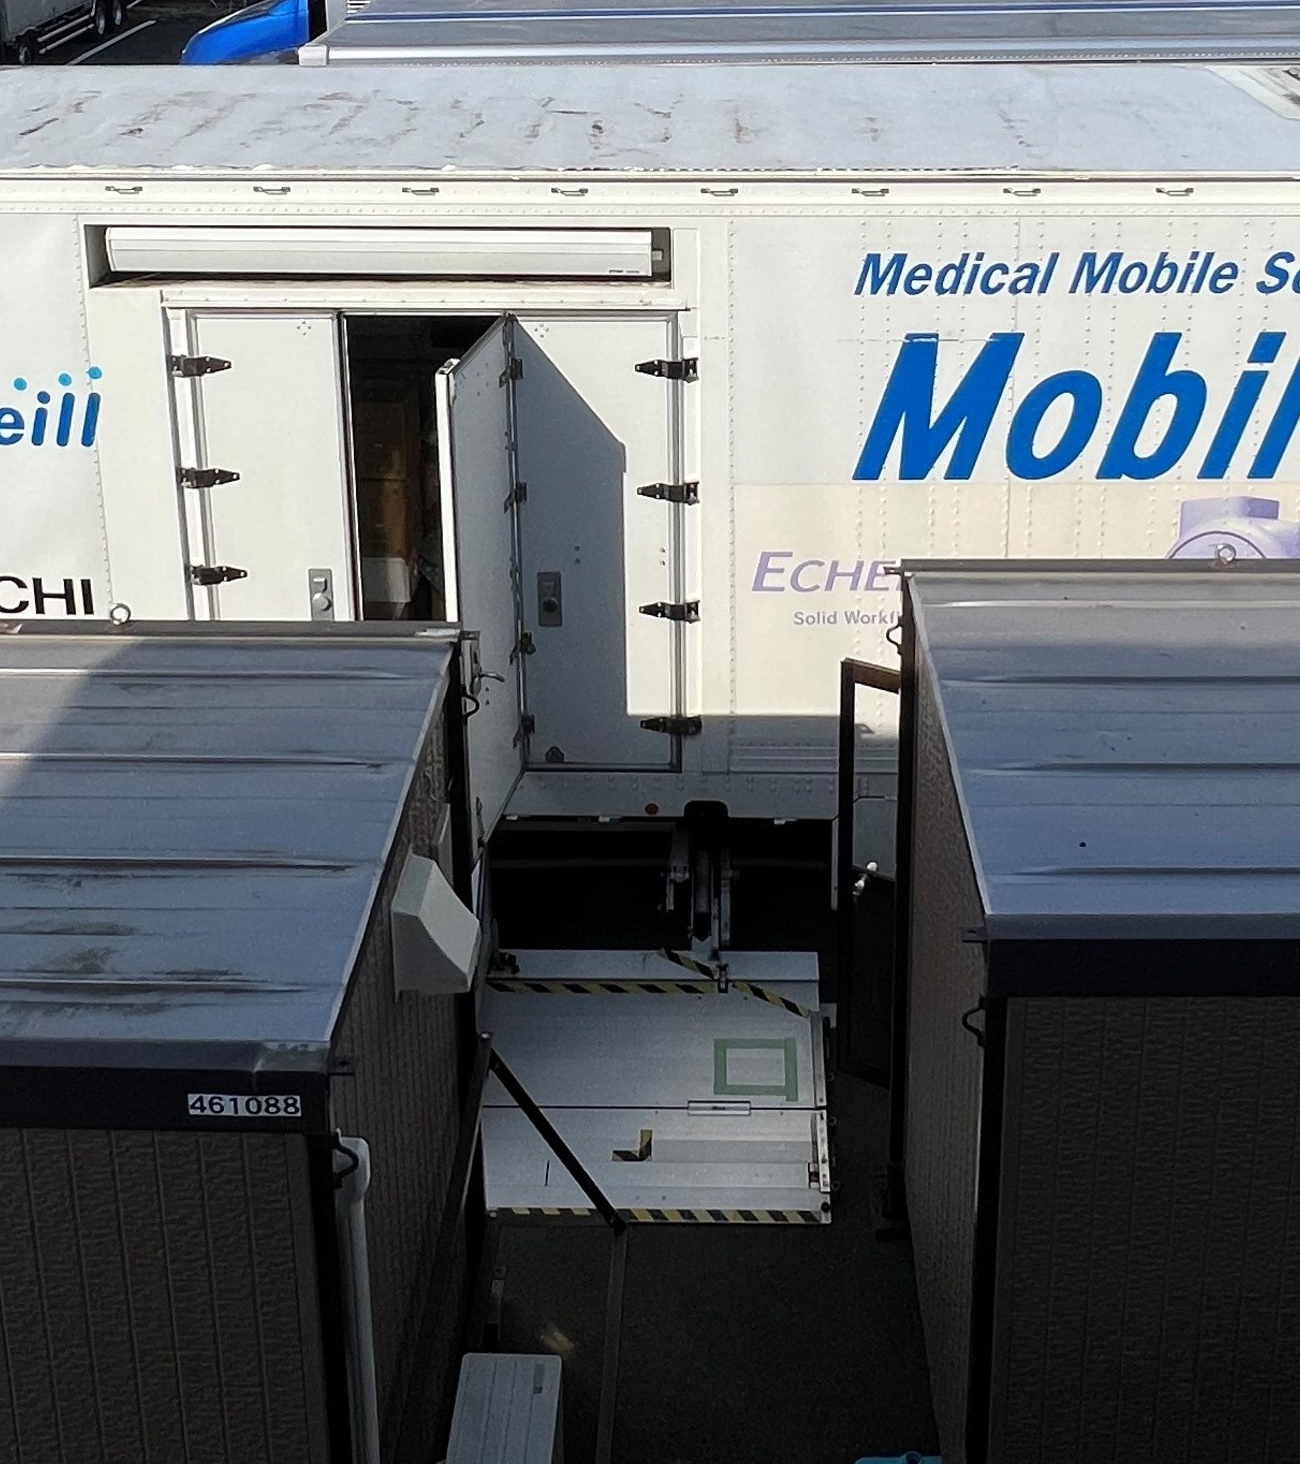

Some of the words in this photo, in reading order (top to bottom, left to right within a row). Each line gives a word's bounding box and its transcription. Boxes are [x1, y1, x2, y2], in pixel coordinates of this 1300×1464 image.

[854, 252, 1057, 296] Medical
[1068, 252, 1240, 296] Mobile
[793, 611, 838, 626] Solid
[189, 1095, 300, 1115] 461088
